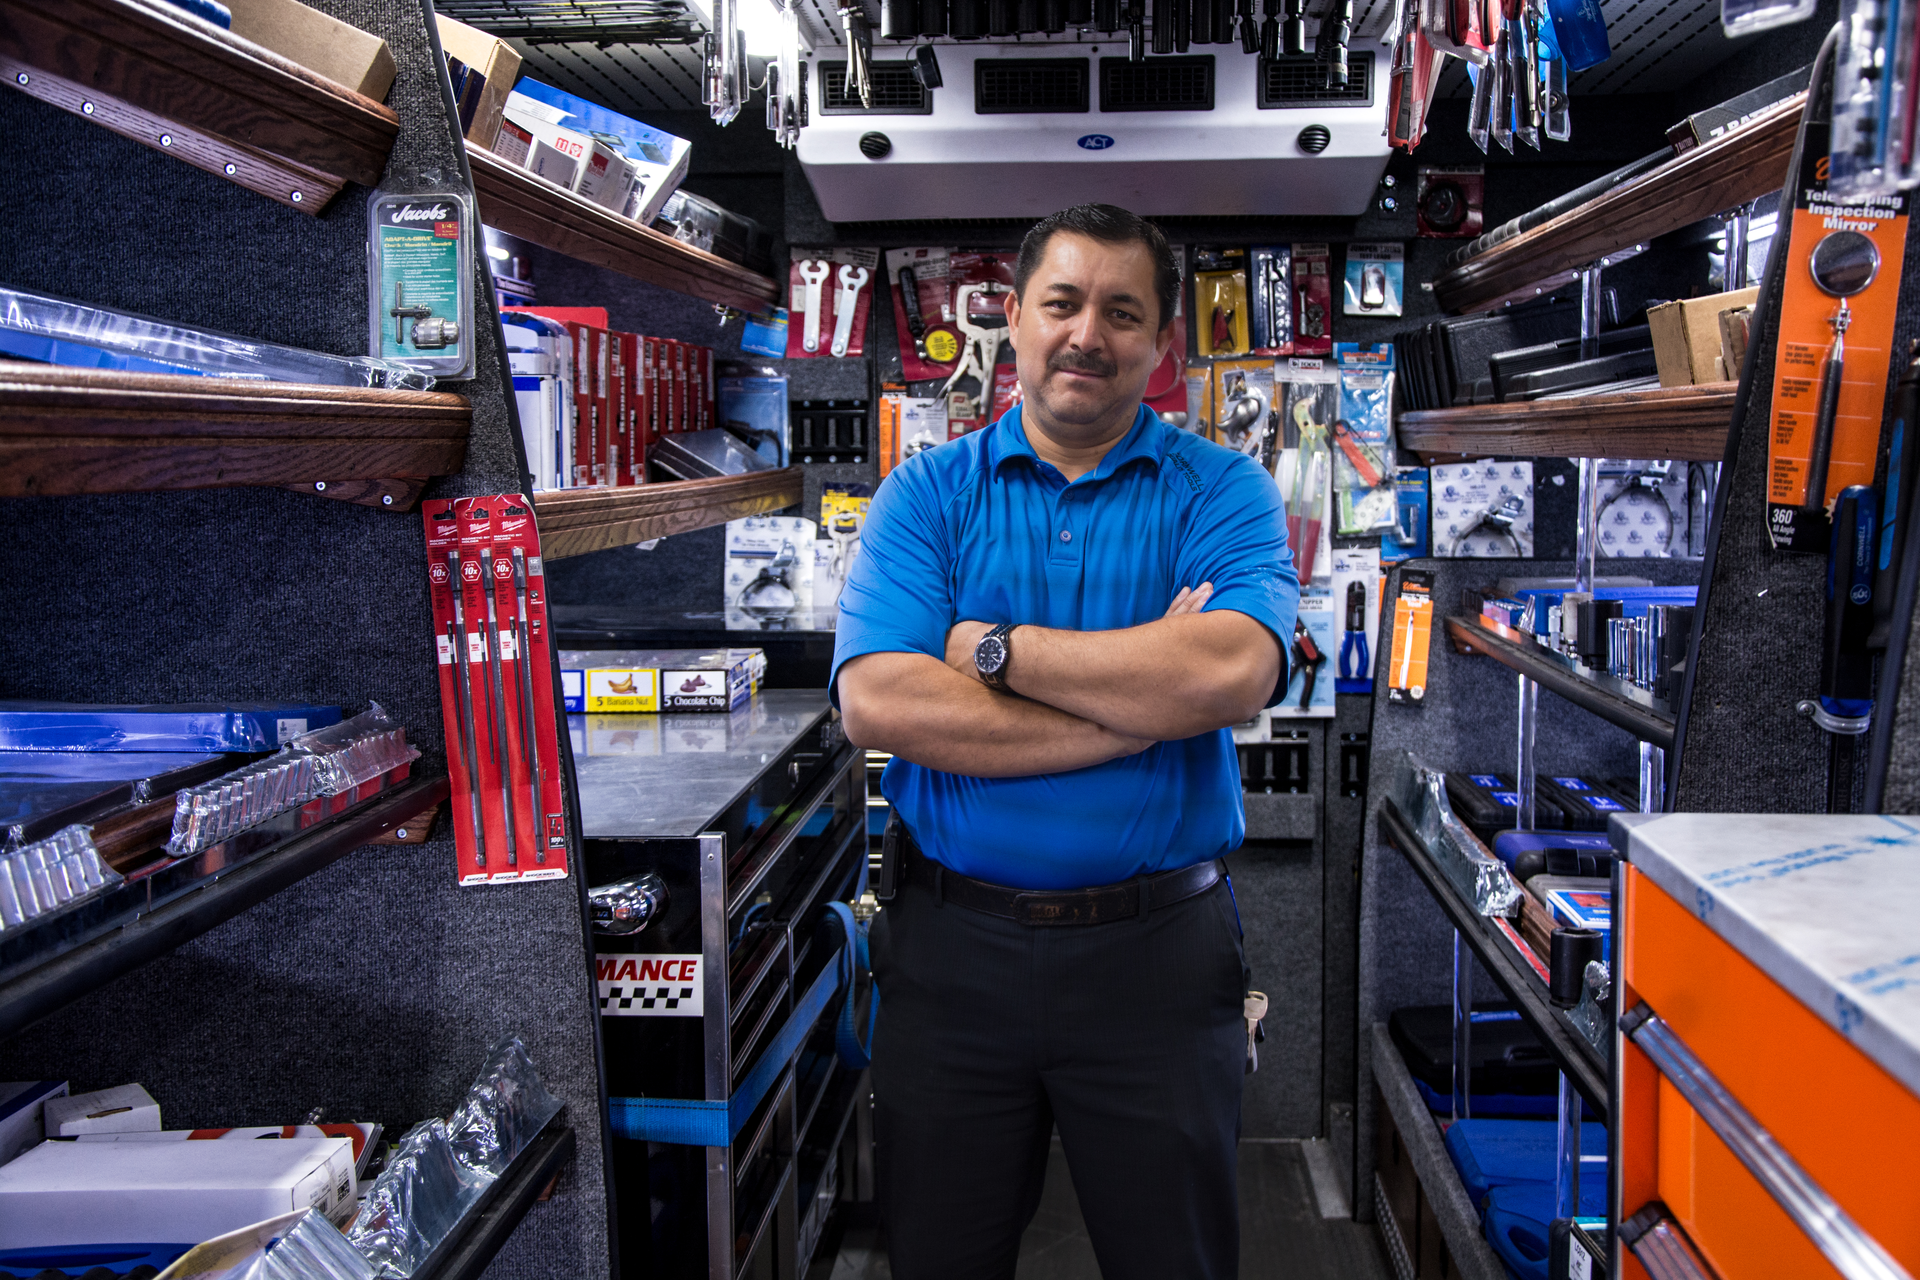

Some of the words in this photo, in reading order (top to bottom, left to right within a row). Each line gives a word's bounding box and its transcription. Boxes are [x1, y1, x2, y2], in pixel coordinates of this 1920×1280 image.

[1084, 136, 1108, 148] ACT
[392, 204, 447, 223] Jacobs
[1808, 203, 1896, 219] Inspection
[1823, 218, 1878, 231] Mirror
[1183, 472, 1198, 491] TOOLS
[1780, 525, 1795, 535] Angle
[1773, 534, 1792, 545] Viewing
[1856, 525, 1865, 566] CORNWELL
[597, 697, 603, 706] 5
[607, 697, 633, 706] Banana
[636, 697, 649, 706] Nut
[664, 696, 671, 707] 5
[674, 696, 707, 706] Chocolate
[708, 696, 725, 707] Chip
[596, 960, 697, 981] MANCE
